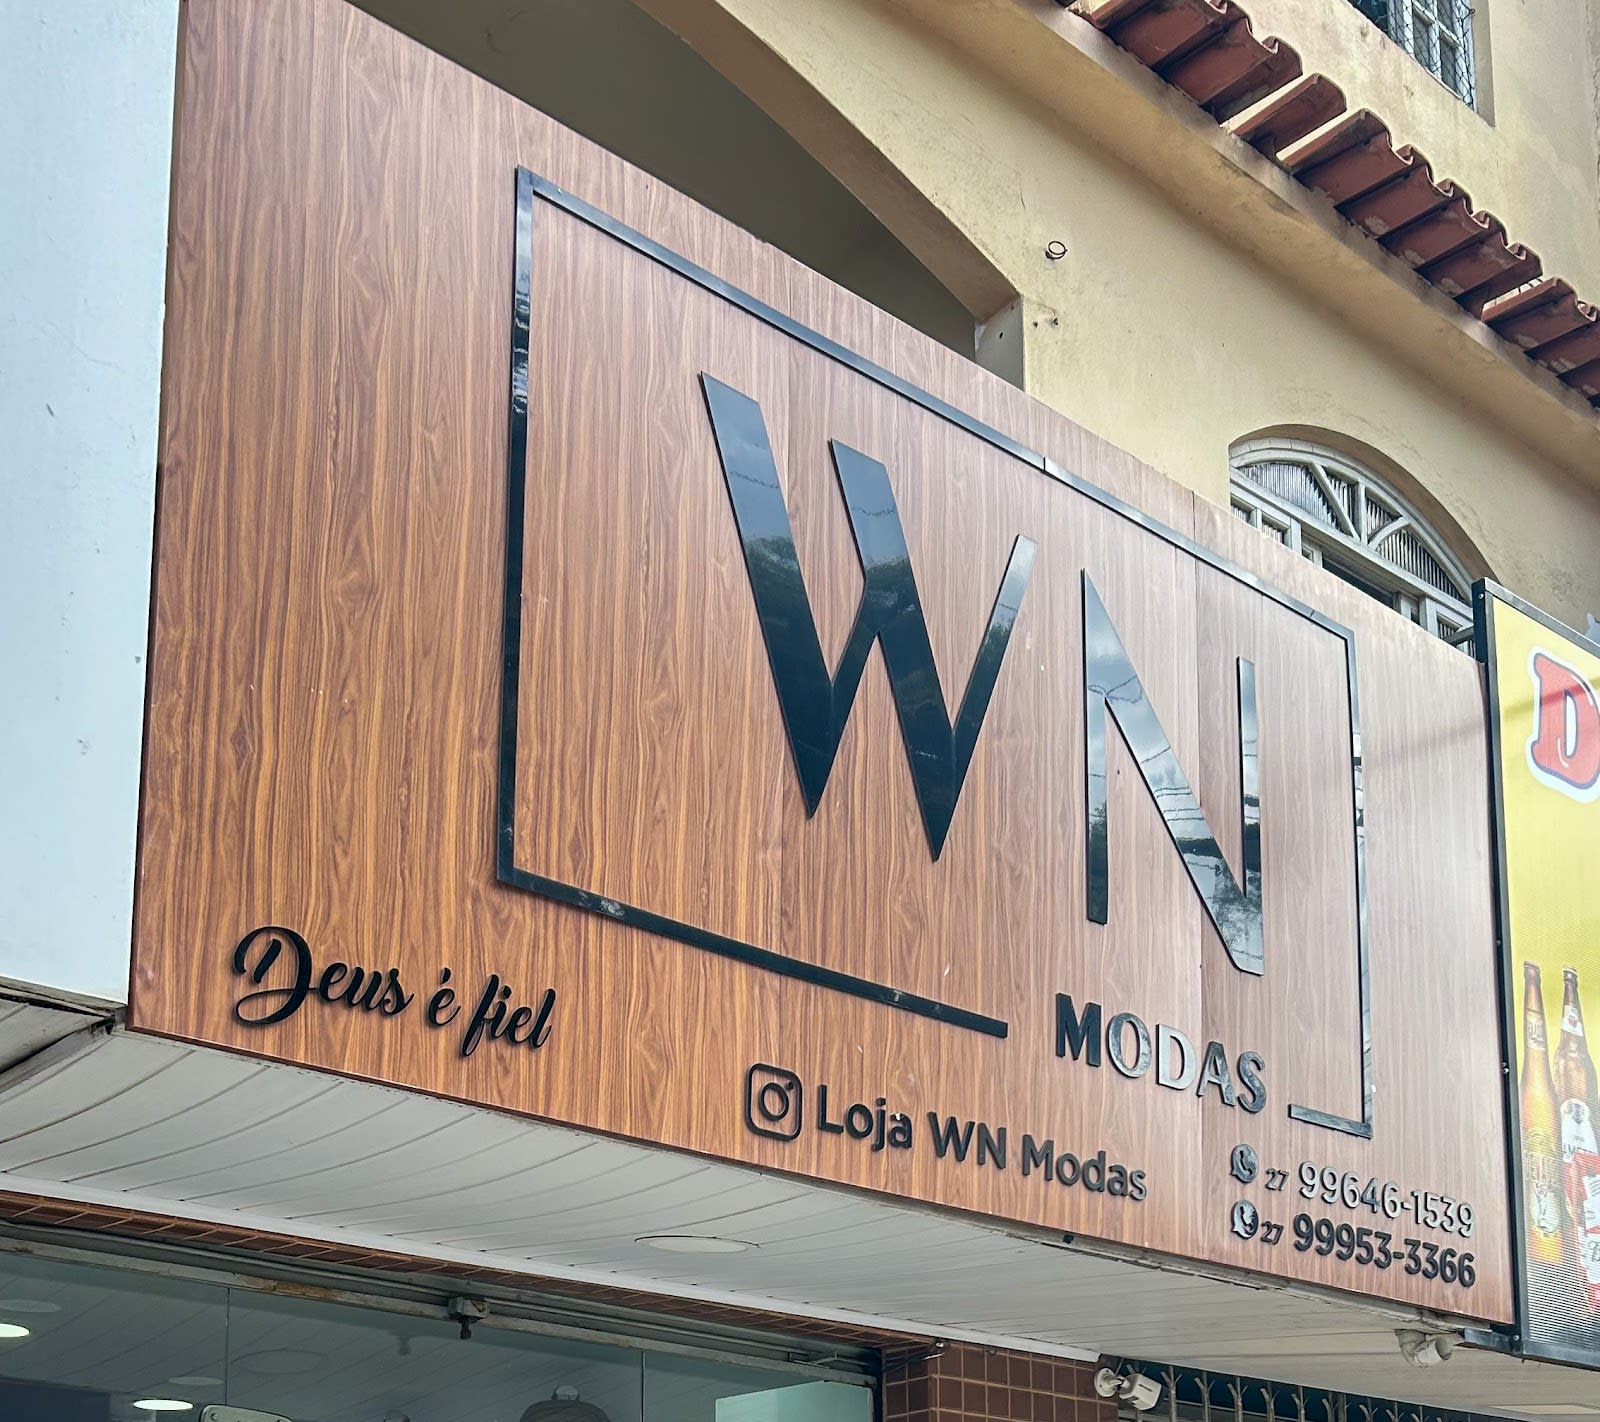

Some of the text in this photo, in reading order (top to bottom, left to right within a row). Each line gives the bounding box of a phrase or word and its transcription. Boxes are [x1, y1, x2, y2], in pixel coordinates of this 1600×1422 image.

[698, 371, 1263, 975] WN
[234, 926, 556, 1057] Deus é fiel
[1056, 993, 1267, 1114] MODAS
[817, 1084, 1147, 1200] Loja WN Modas
[1264, 1167, 1289, 1191] 27
[1299, 1161, 1476, 1238] 99646-1539
[1260, 1213, 1476, 1287] 27 99953-3366
